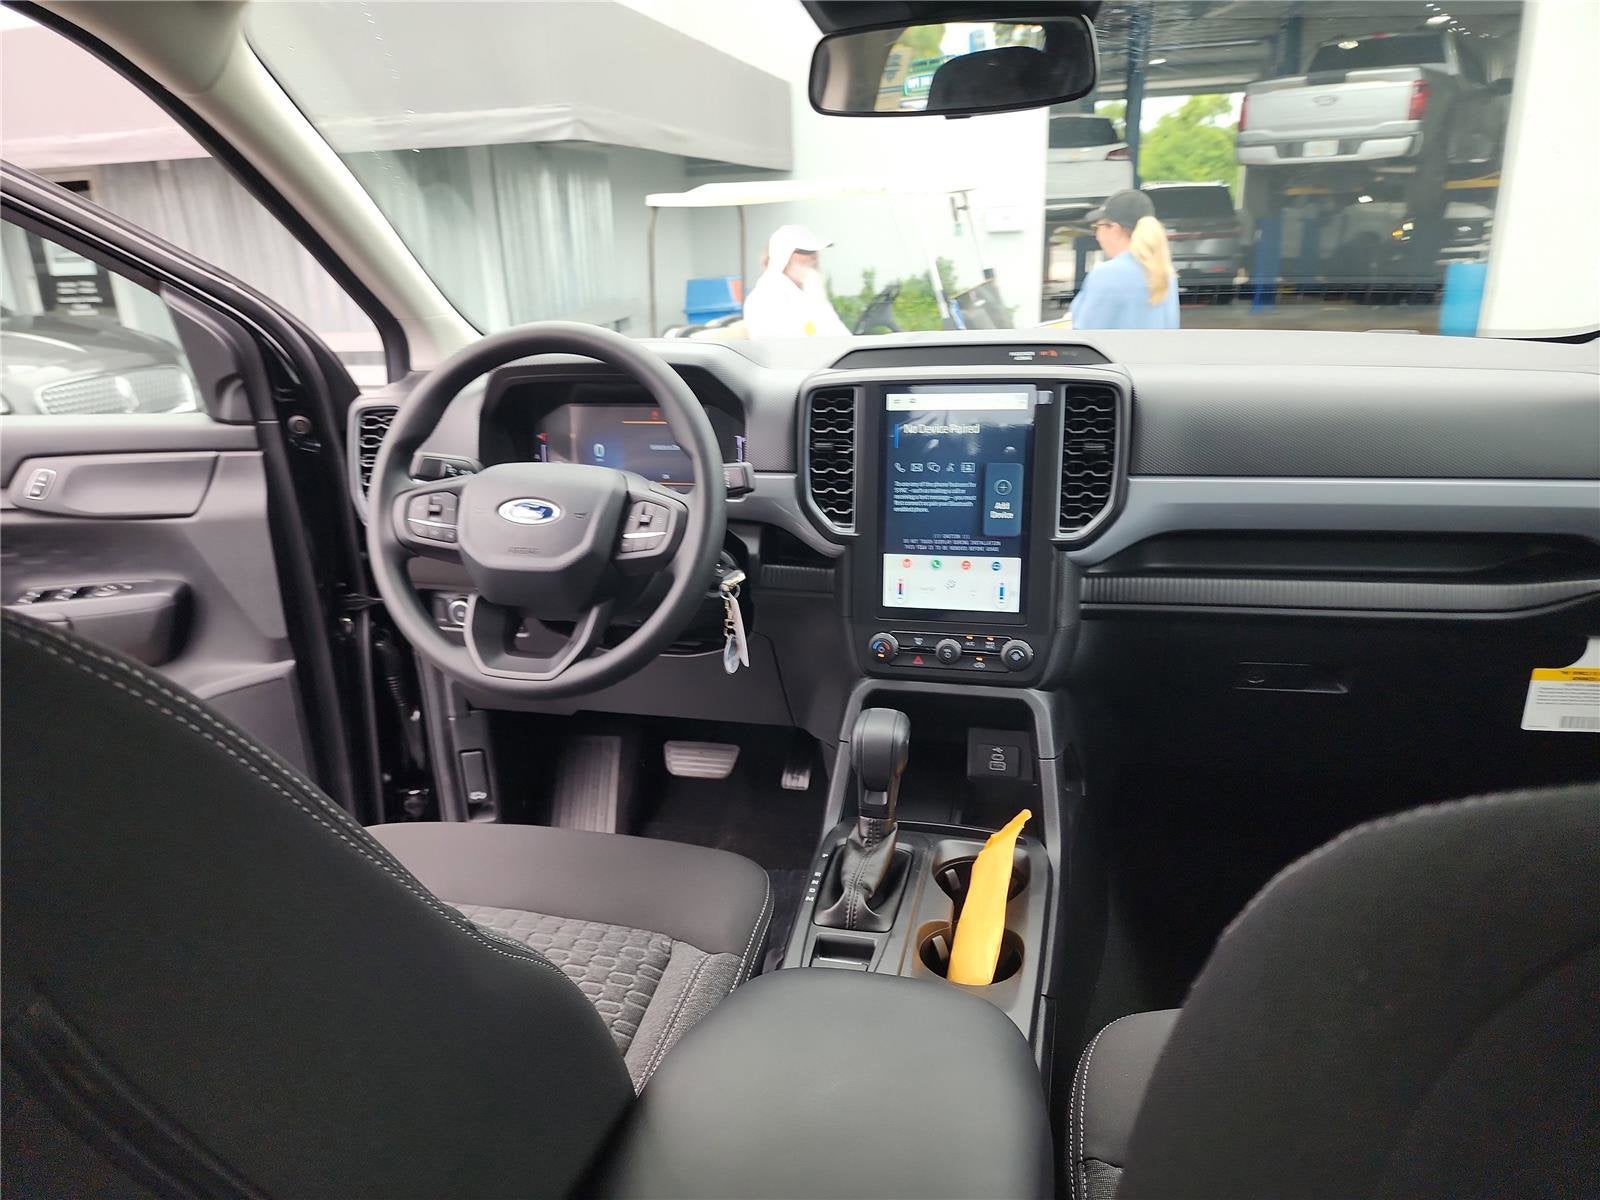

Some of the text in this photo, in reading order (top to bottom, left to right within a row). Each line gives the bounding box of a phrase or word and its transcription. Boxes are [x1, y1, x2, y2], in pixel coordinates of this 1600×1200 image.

[903, 423, 981, 434] No Device Paired
